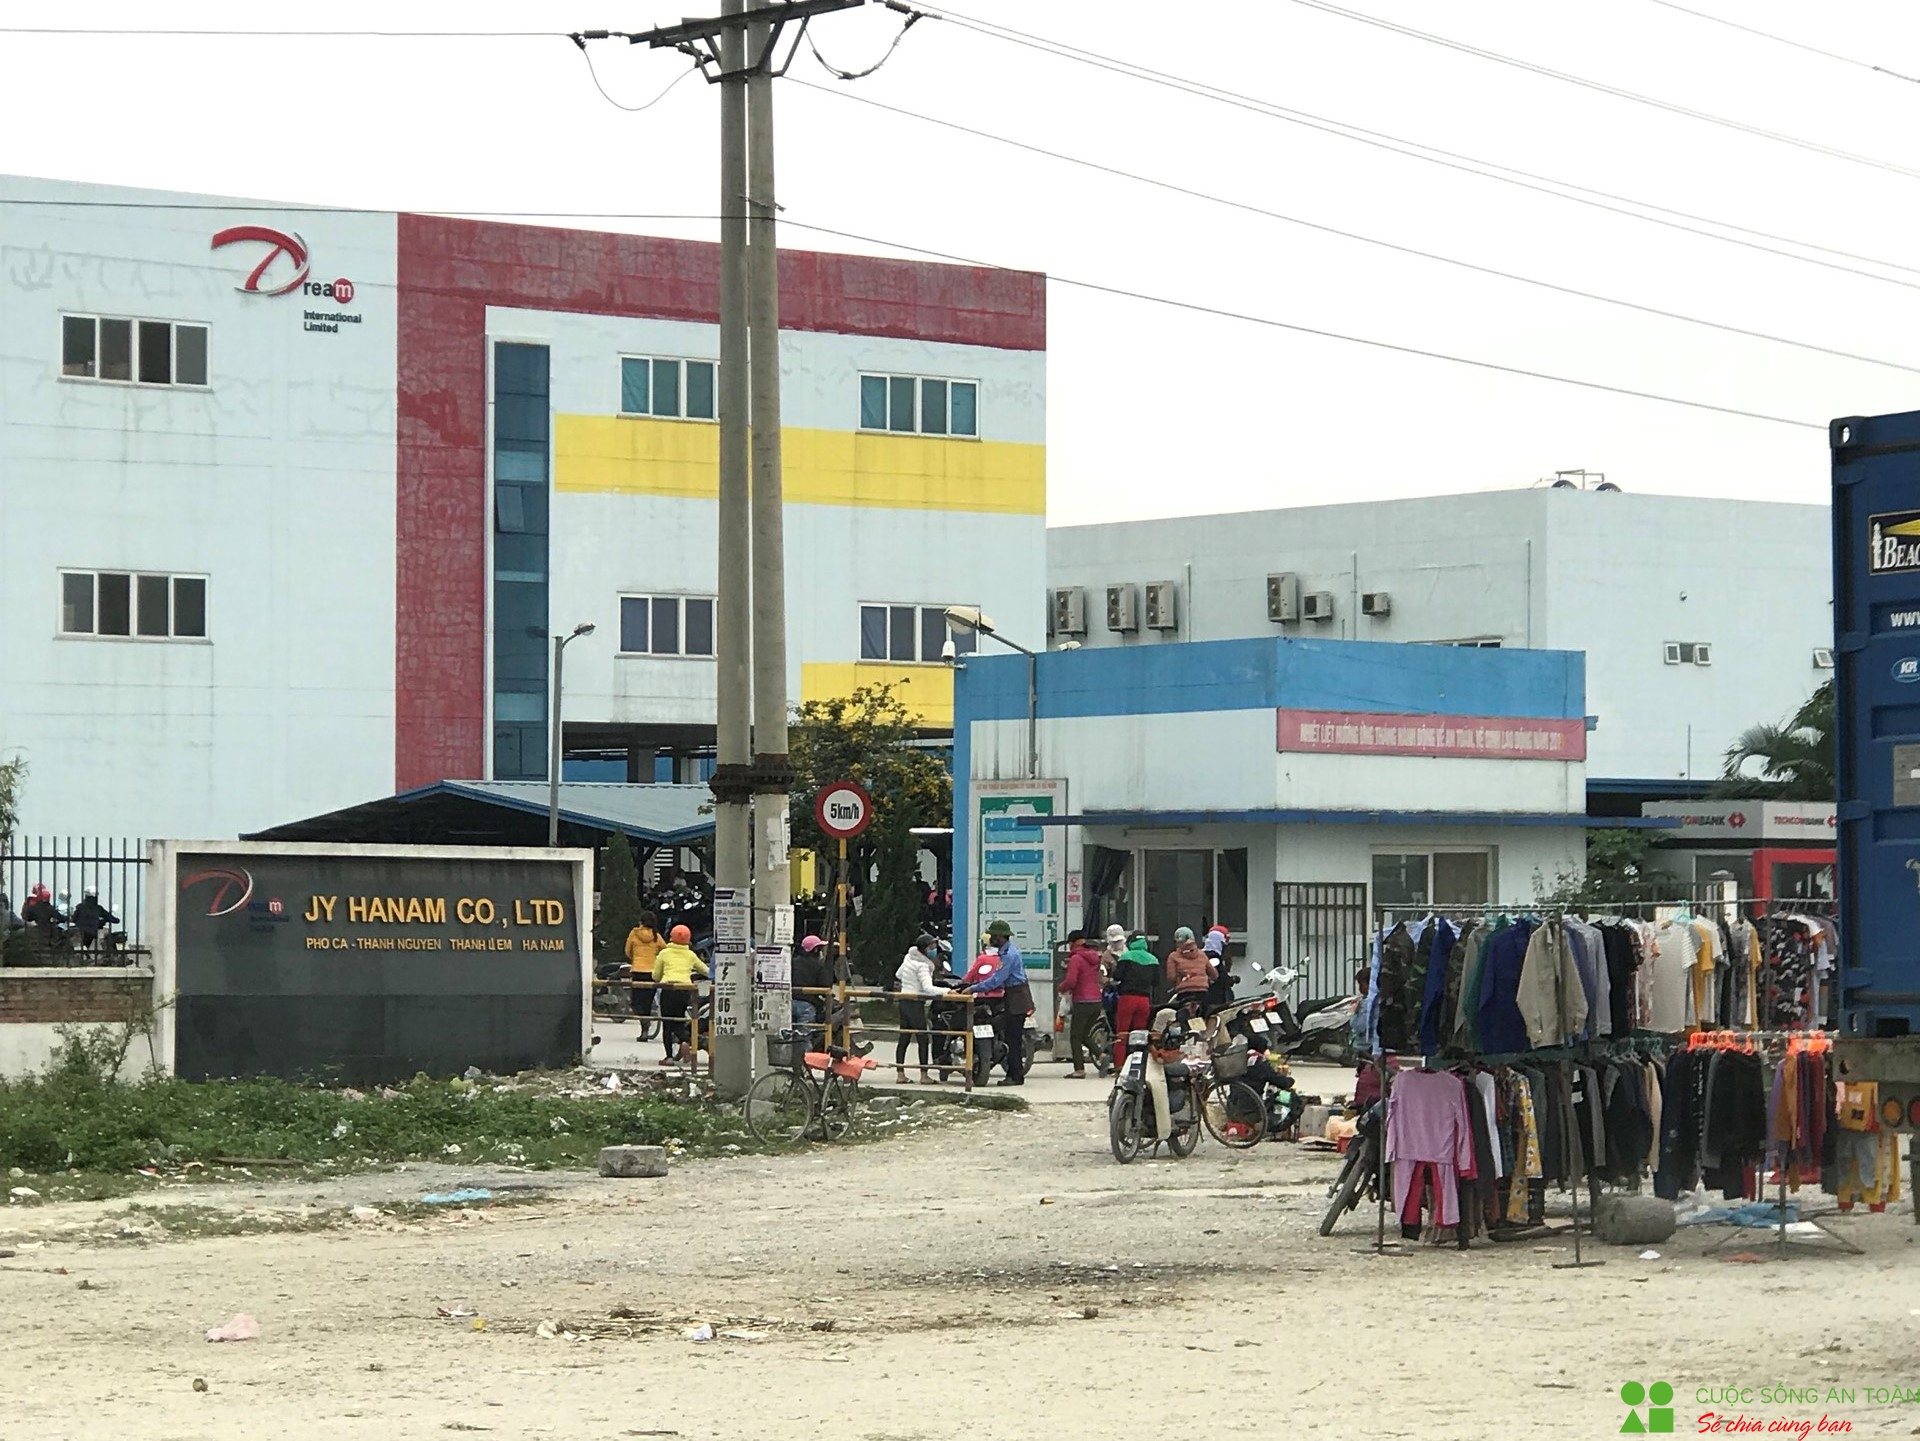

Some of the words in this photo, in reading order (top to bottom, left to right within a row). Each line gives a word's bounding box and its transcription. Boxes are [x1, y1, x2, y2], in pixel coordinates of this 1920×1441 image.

[303, 310, 362, 324] International
[303, 322, 338, 333] Limited
[830, 803, 860, 820] 5km/h
[305, 896, 337, 922] JY
[349, 896, 446, 923] HANAM
[515, 899, 564, 925] LTD
[306, 938, 329, 949] PHO
[332, 938, 348, 949] CA
[357, 938, 394, 949] THANH
[397, 938, 441, 950] NGUYEN
[449, 938, 486, 950] THANH
[522, 939, 538, 950] HA
[540, 939, 564, 950] NAM
